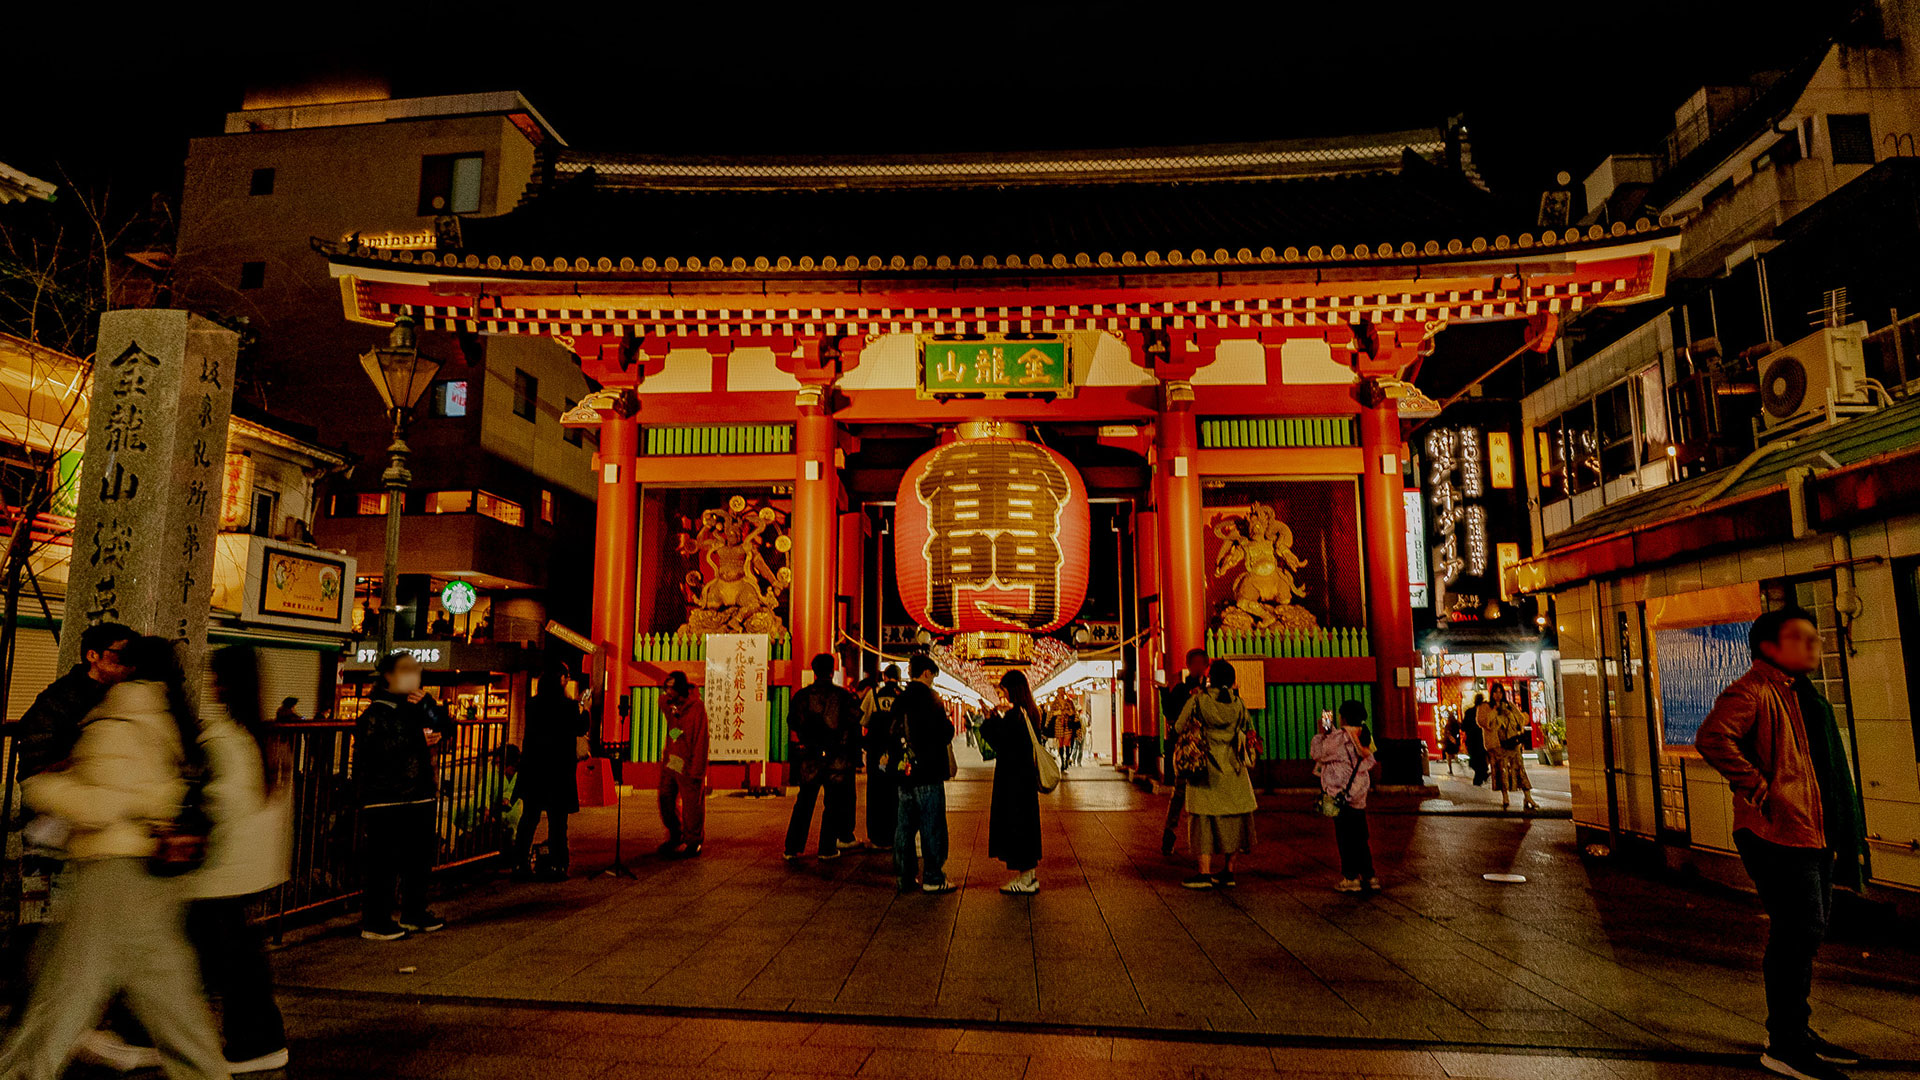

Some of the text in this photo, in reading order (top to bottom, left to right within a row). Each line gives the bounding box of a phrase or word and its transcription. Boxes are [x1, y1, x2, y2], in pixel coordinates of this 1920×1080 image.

[936, 346, 1055, 385] 金龍山
[357, 648, 440, 663] STCKS
[732, 639, 747, 741] 文化芸能人節分会
[754, 663, 765, 703] 二月三日
